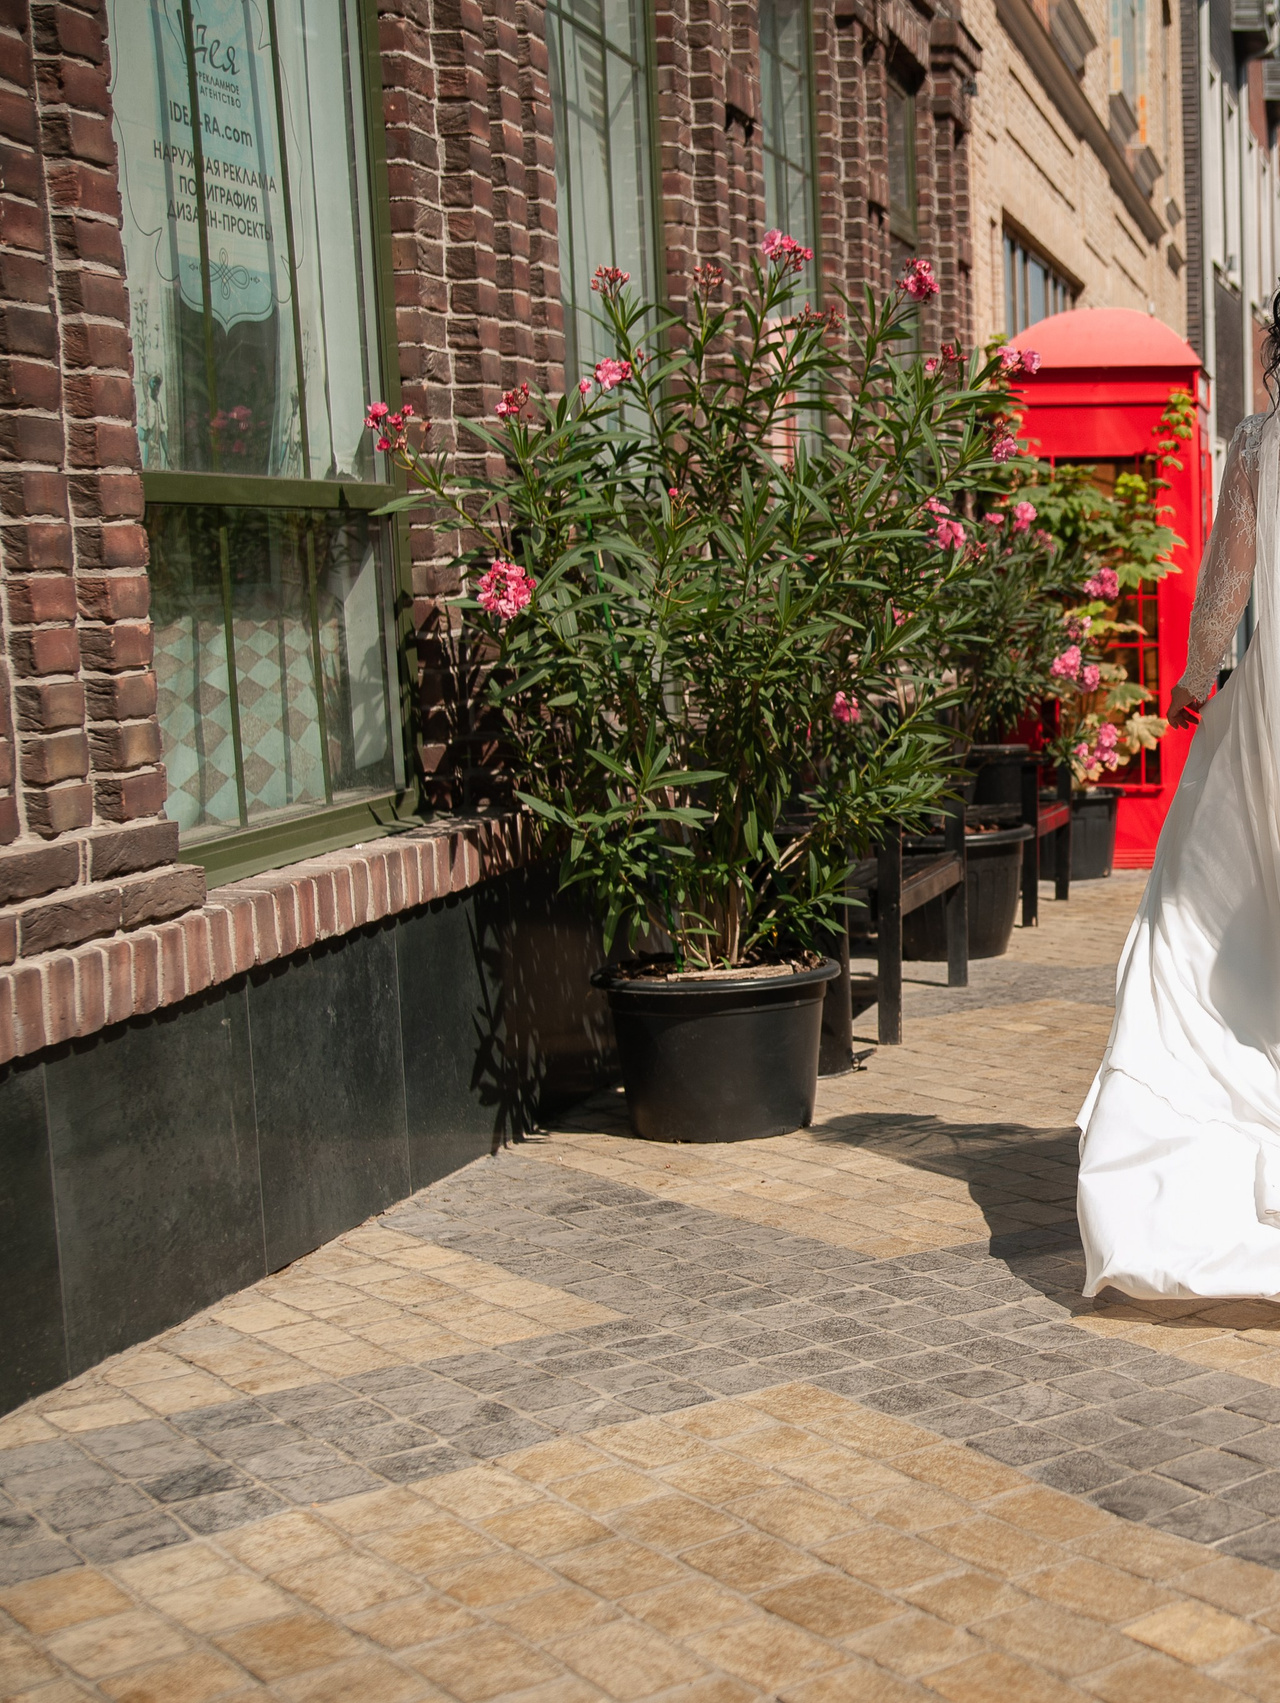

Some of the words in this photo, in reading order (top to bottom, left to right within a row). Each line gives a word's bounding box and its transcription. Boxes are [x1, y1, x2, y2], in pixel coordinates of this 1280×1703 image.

[198, 71, 240, 96] РЕКЛАМНОЕ
[199, 85, 242, 109] АГЕНТСТВО
[169, 99, 253, 148] IDE-RA.com
[153, 139, 222, 178] НАРУЖАЯ
[223, 161, 277, 194] РЕКЛАМА
[179, 175, 259, 214] ПОИГРАФИЯ
